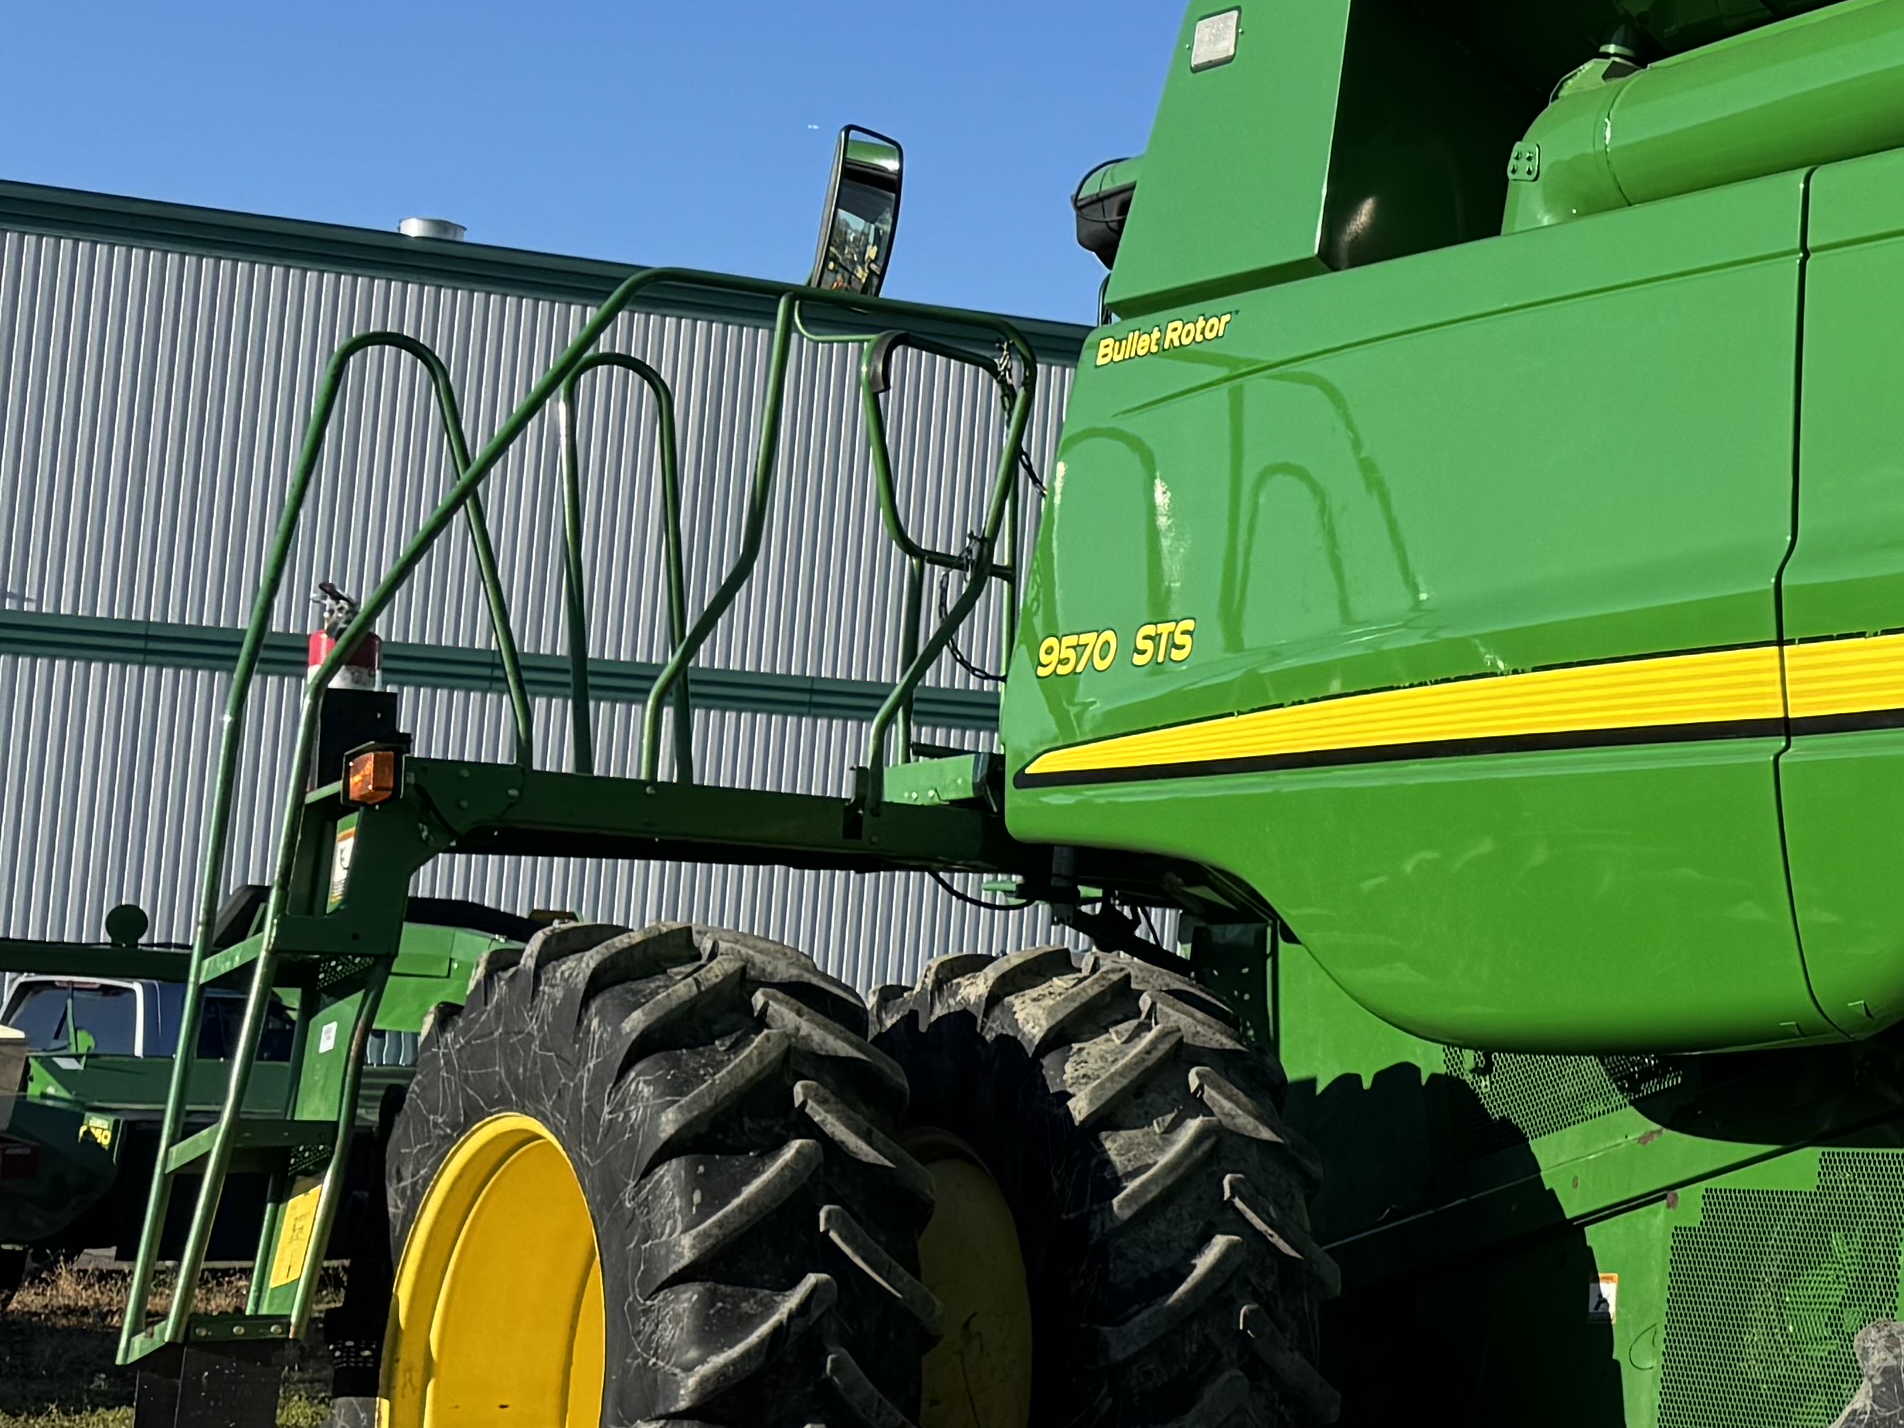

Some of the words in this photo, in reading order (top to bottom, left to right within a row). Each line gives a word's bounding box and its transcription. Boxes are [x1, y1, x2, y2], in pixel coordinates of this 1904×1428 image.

[1095, 325, 1161, 368] Bullet
[1163, 313, 1233, 351] Rotor
[1036, 629, 1118, 678] 9570
[1132, 618, 1196, 666] STS
